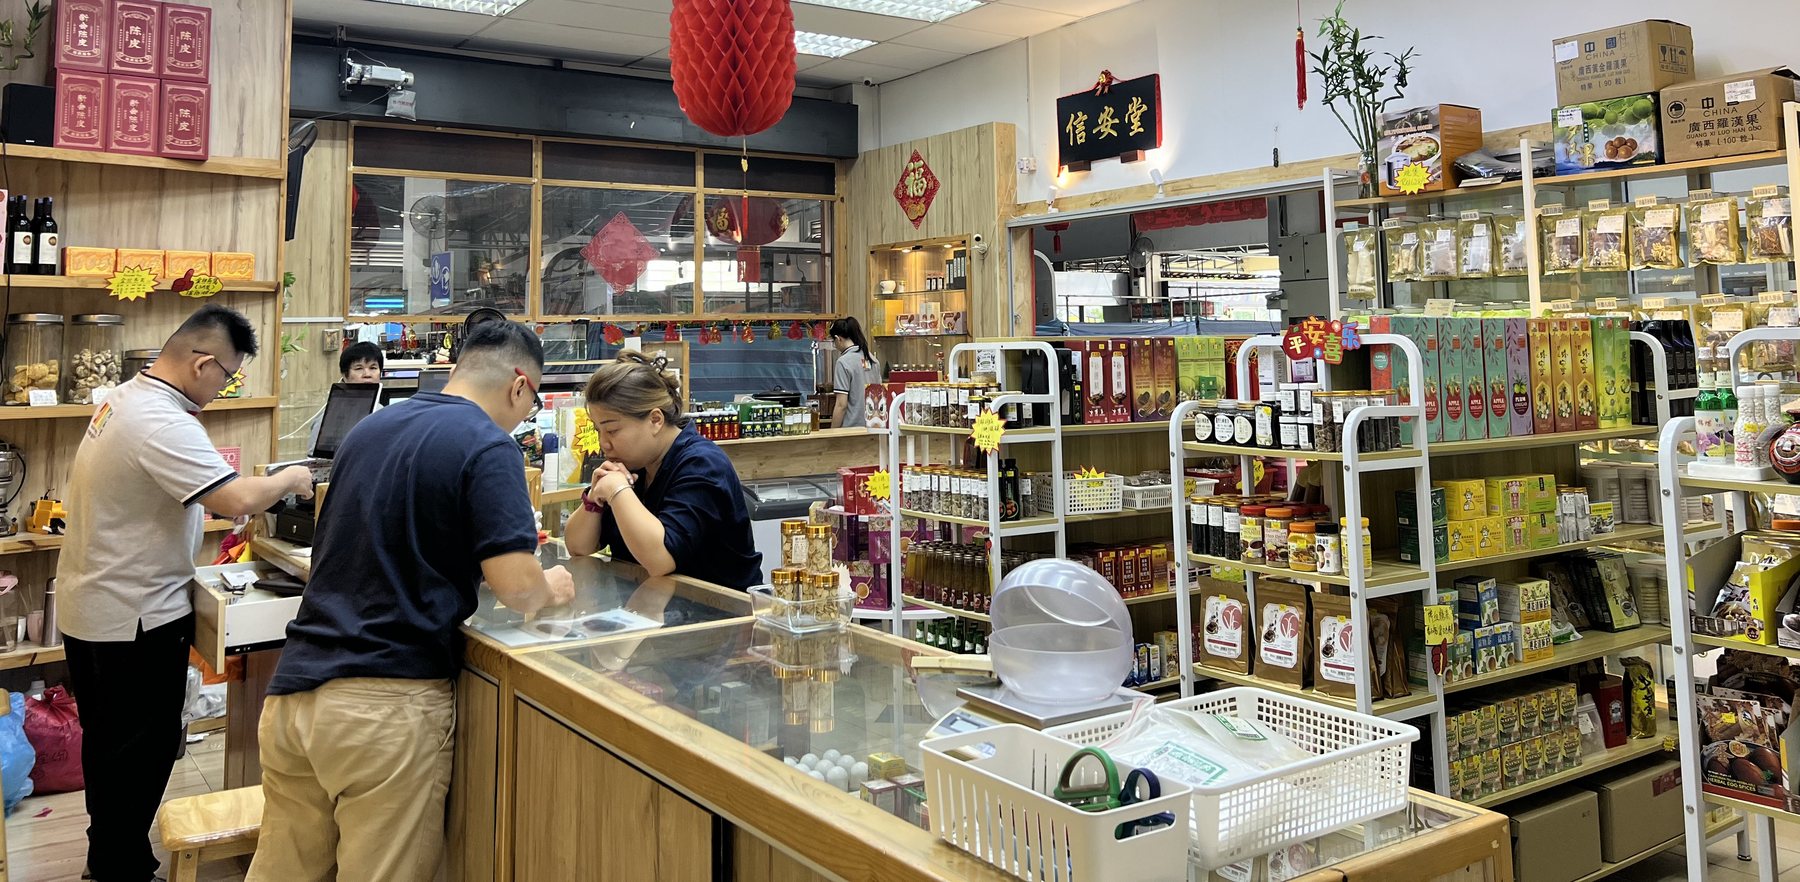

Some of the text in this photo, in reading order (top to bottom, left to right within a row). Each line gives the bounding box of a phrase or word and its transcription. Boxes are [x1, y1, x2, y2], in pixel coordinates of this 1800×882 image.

[1585, 50, 1615, 61] CHINA
[1703, 107, 1738, 118] CHINA
[1065, 96, 1148, 146] 信安堂
[905, 160, 928, 198] 福
[1708, 776, 1726, 786] HERBAL
[1738, 784, 1756, 792] SPICES
